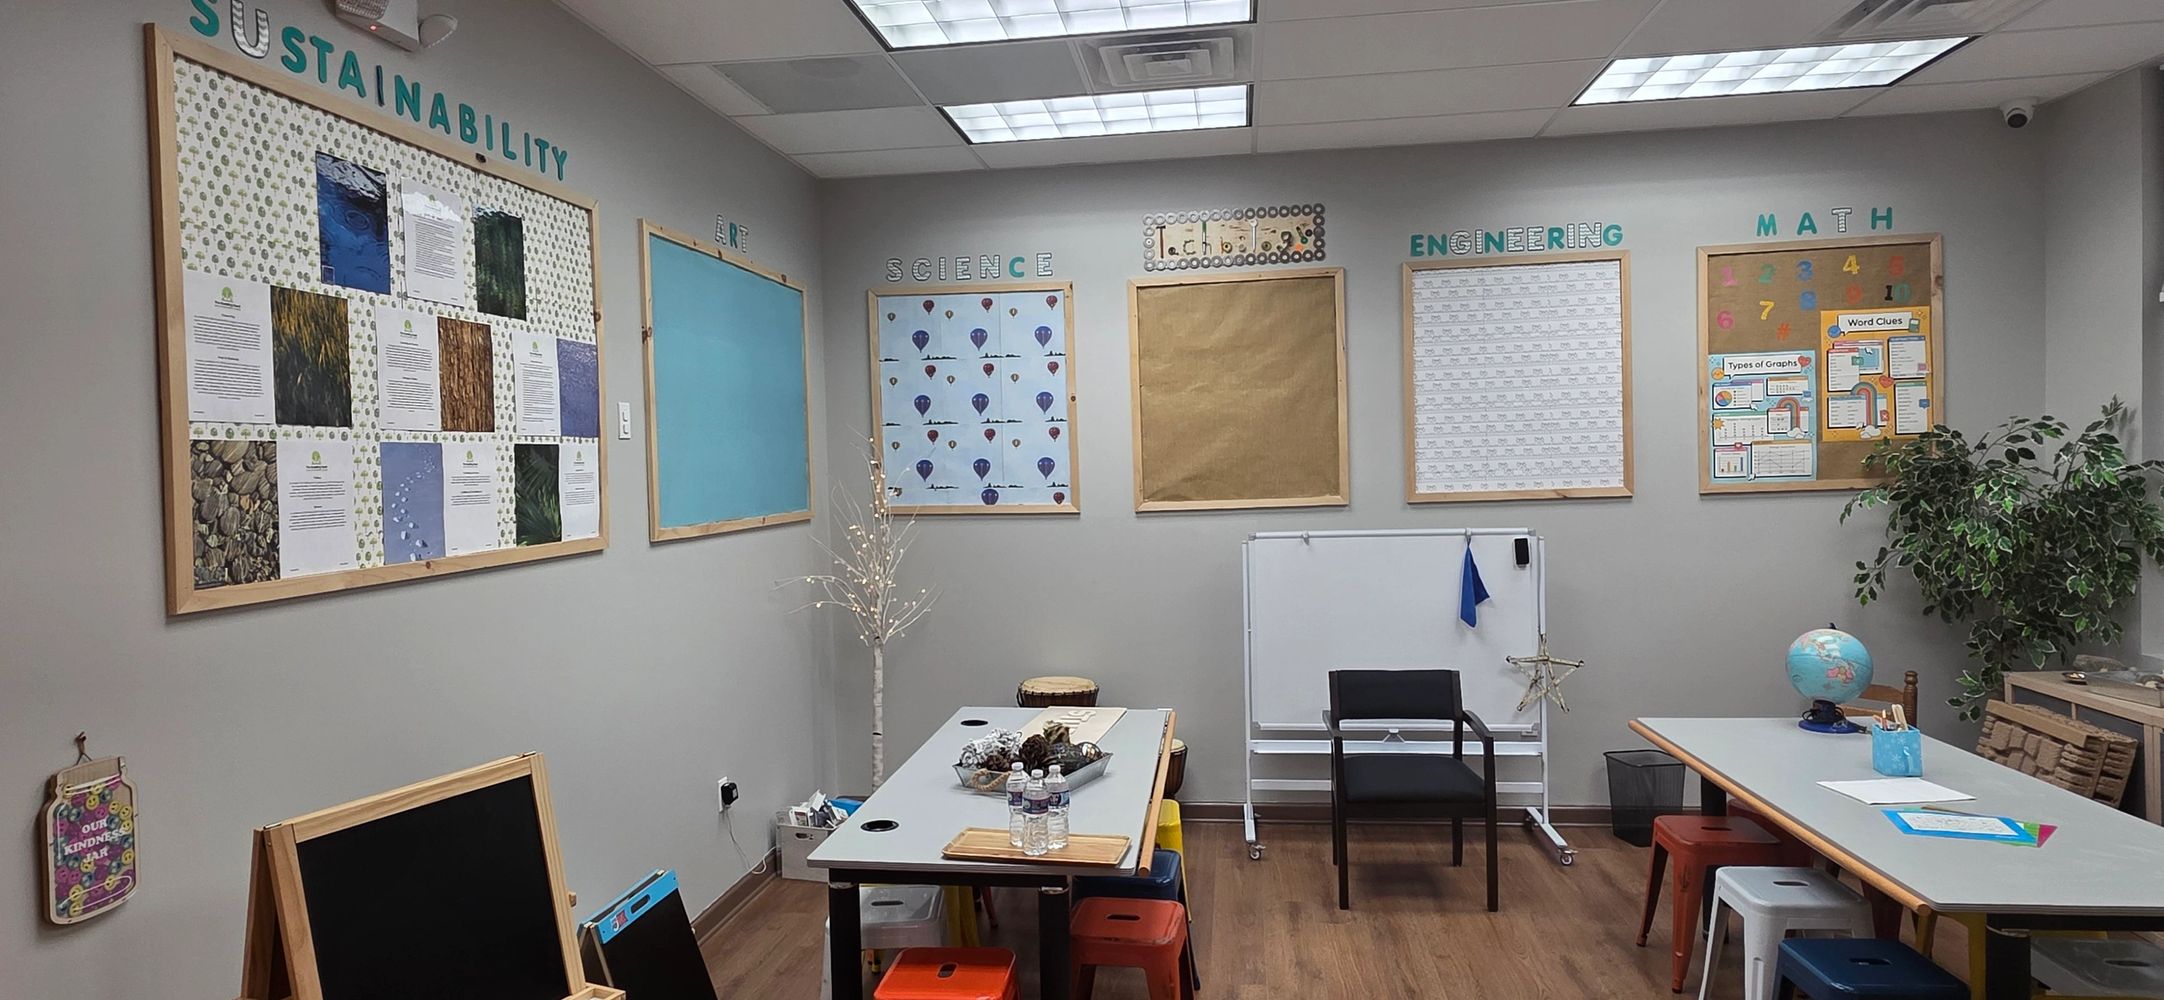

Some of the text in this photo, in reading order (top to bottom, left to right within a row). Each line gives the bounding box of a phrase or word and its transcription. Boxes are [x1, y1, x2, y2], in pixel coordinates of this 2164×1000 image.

[189, 0, 568, 181] SUSTAINABILITY
[714, 214, 749, 253] ART
[1756, 207, 1893, 236] MATH
[1410, 222, 1623, 257] ENGINEERING
[885, 252, 1053, 282] SCIENCE
[1721, 266, 1738, 287] 1
[1759, 263, 1776, 283] 2
[1796, 260, 1813, 281] 3
[1842, 255, 1861, 275] 4
[1716, 309, 1734, 330] 6
[1759, 301, 1775, 320] 7
[1885, 282, 1911, 303] 10
[1848, 317, 1903, 327] Word Clues
[1728, 360, 1798, 370] Types of Graphs
[82, 818, 108, 834] OUR
[63, 827, 125, 856] KINDNESS
[83, 848, 108, 863] JAR
